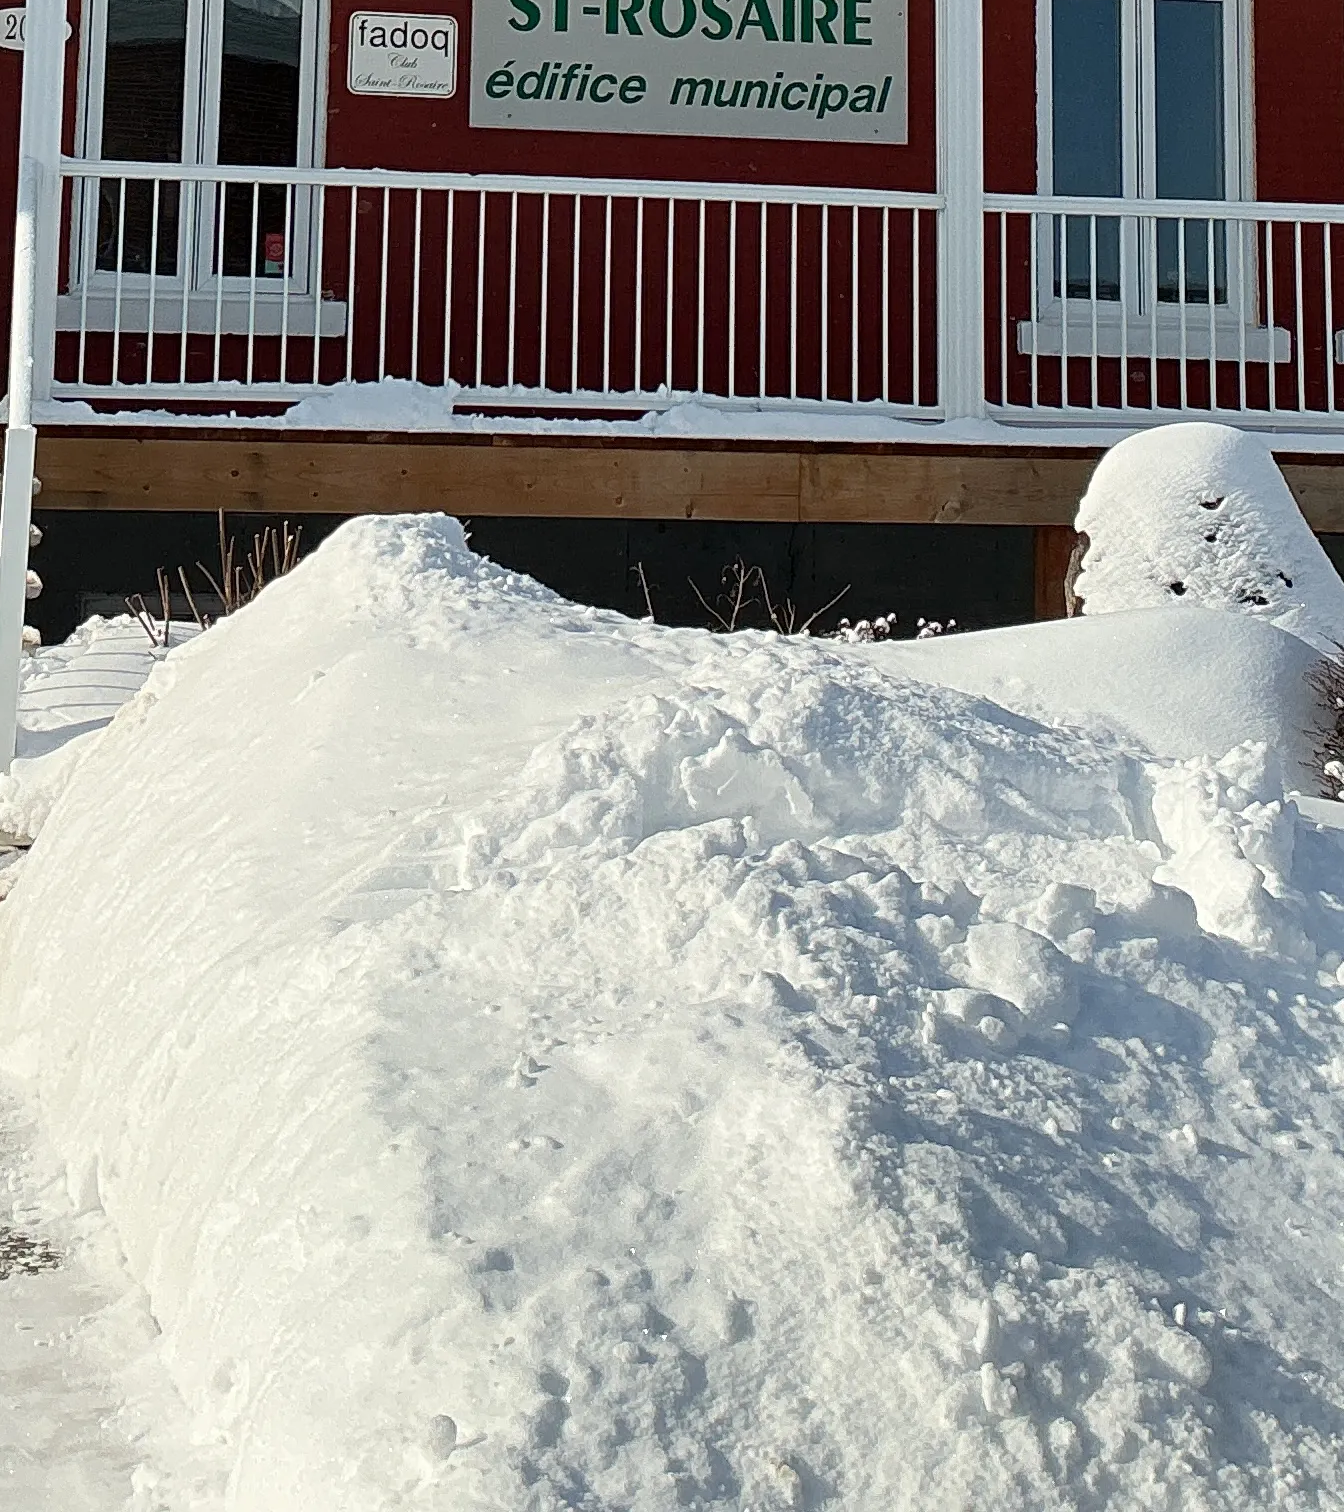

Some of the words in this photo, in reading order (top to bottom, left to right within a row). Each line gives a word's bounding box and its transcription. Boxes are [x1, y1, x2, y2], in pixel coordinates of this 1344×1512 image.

[358, 18, 449, 58] fadoq
[387, 51, 419, 69] Club
[485, 60, 647, 105] édifice
[669, 73, 893, 120] municipal
